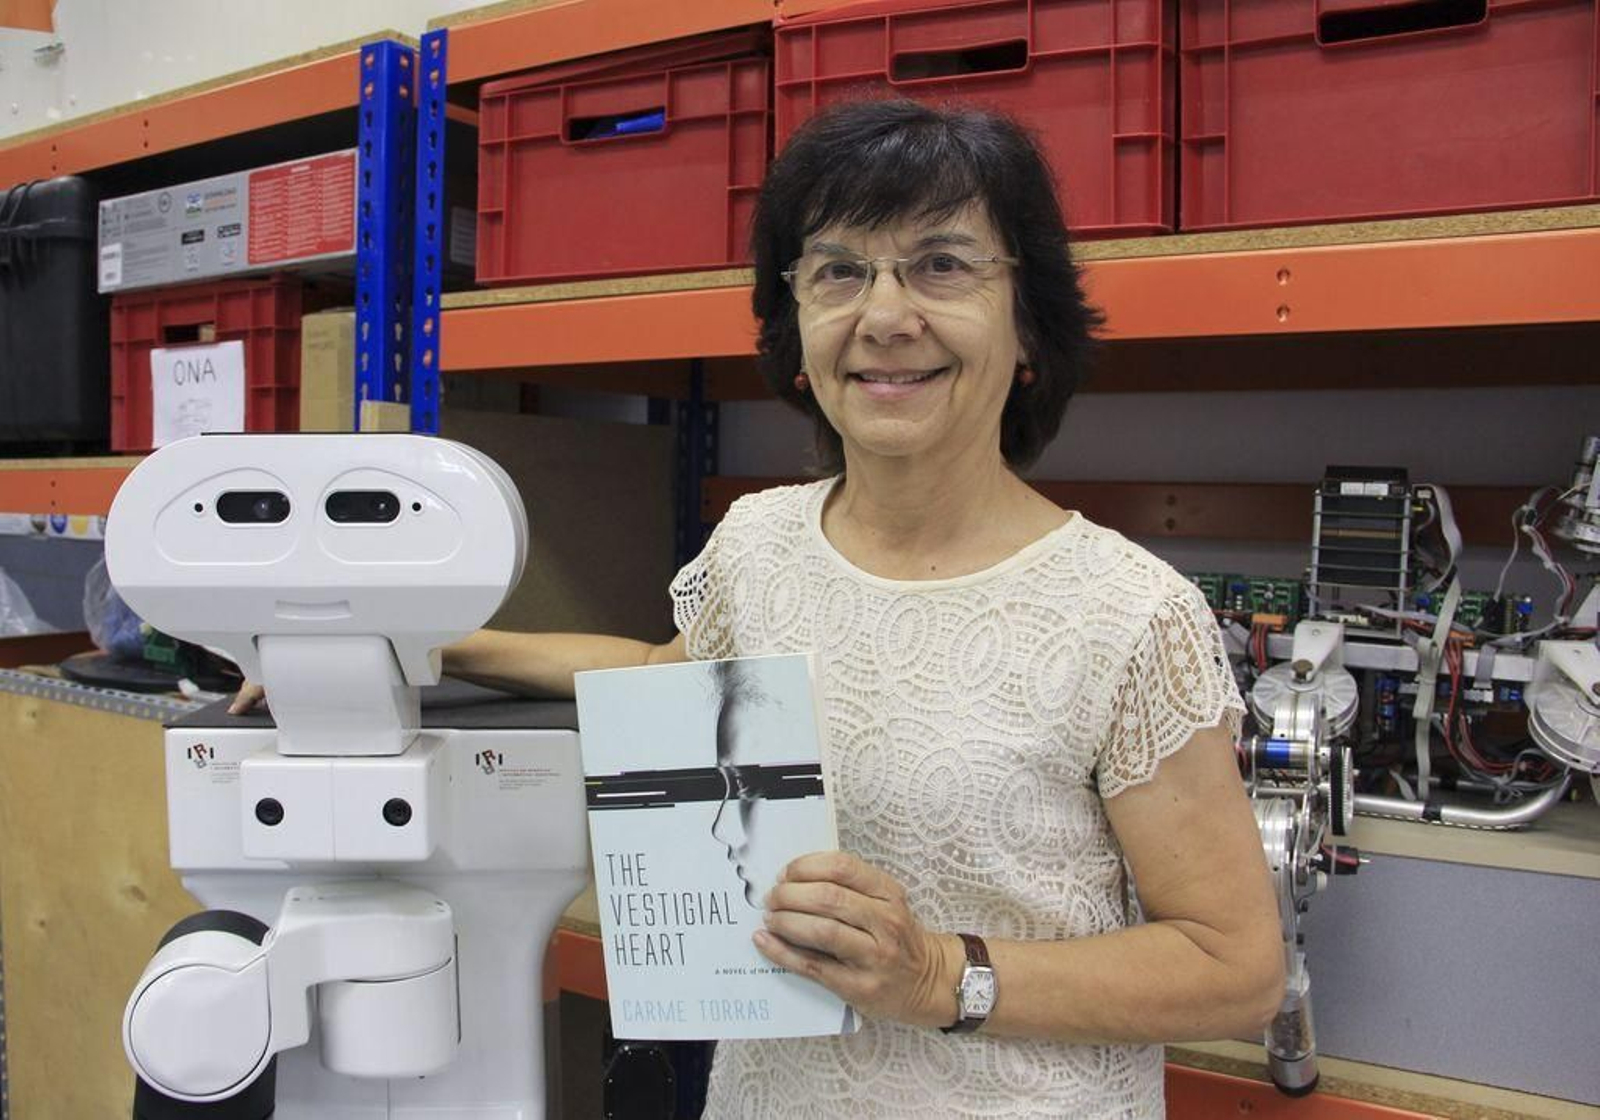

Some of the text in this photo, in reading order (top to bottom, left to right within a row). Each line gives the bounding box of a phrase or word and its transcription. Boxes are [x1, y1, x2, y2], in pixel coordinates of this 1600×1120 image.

[173, 358, 218, 387] ONA
[606, 853, 648, 886] THE
[610, 891, 738, 926] VESTIGIAL
[614, 933, 686, 966] HEART
[714, 967, 720, 975] A
[722, 967, 747, 975] NOVEL
[749, 966, 757, 975] of
[757, 966, 769, 975] the
[622, 998, 770, 1023] CARME TORRAS
